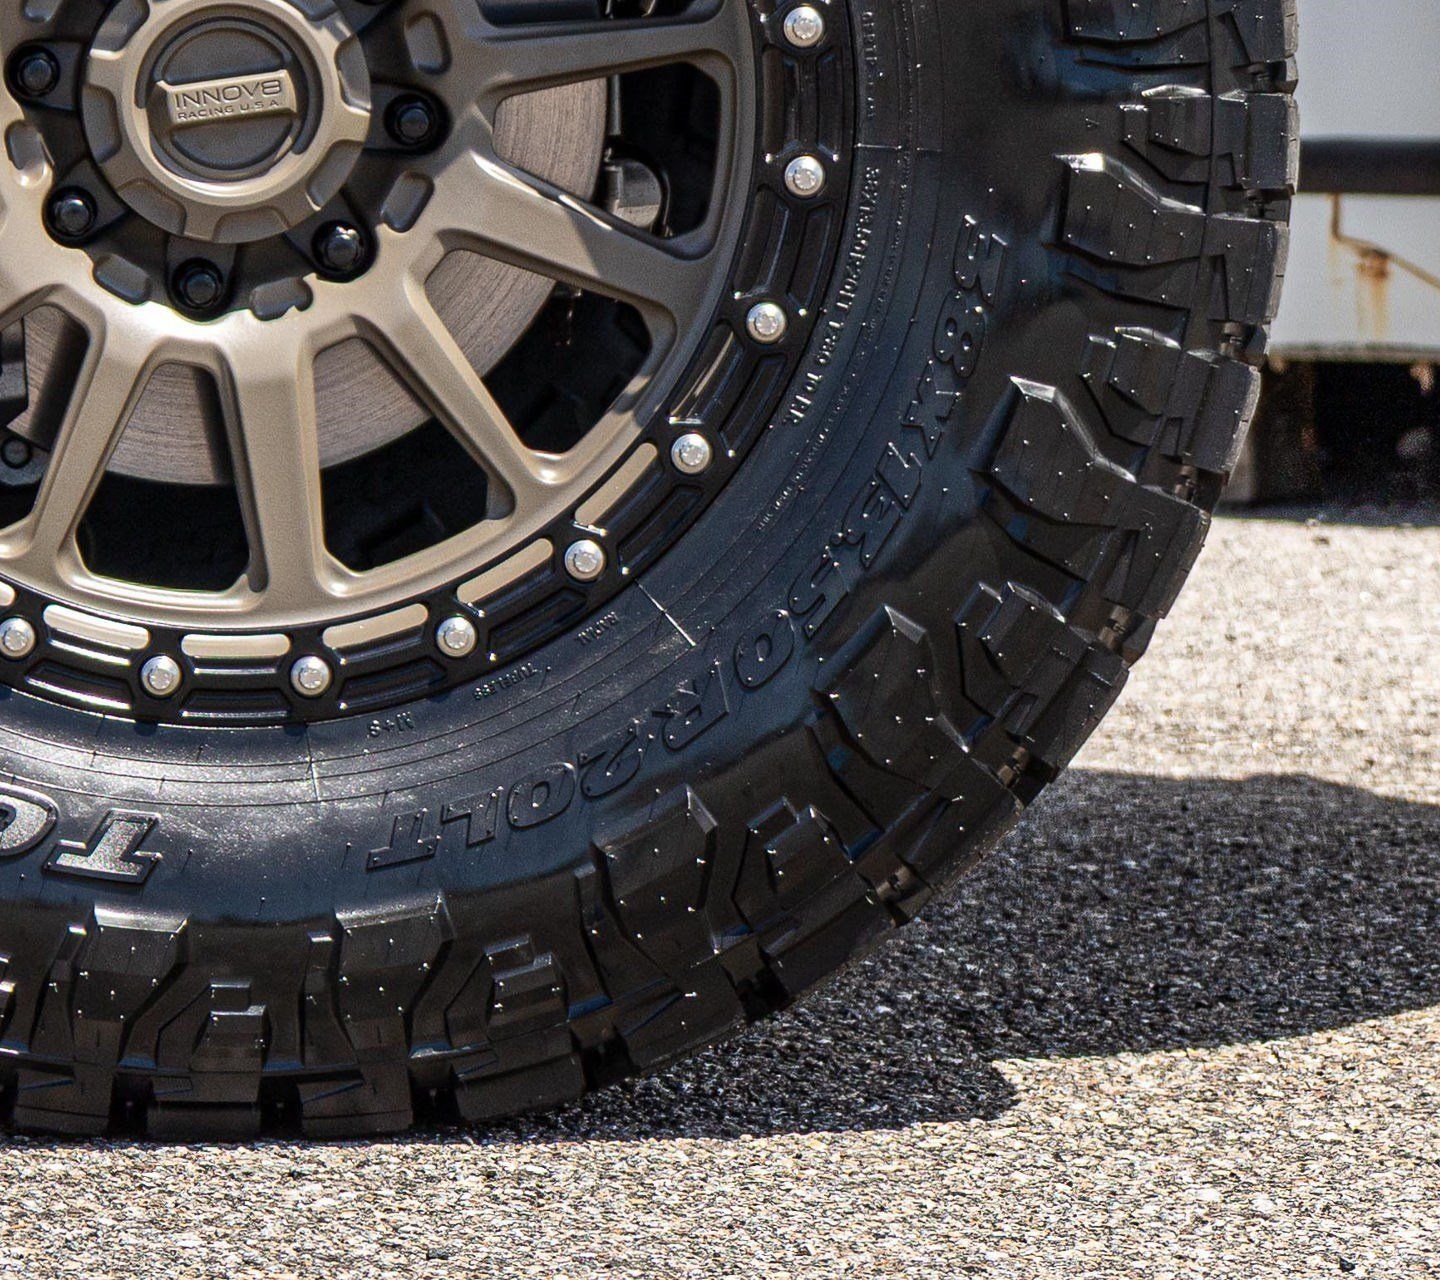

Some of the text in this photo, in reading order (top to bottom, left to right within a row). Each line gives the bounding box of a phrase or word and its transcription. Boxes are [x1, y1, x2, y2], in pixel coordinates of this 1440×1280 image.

[174, 79, 282, 108] INNOV8
[177, 105, 234, 120] RACING
[365, 212, 1009, 872] 38X13.50R20LT
